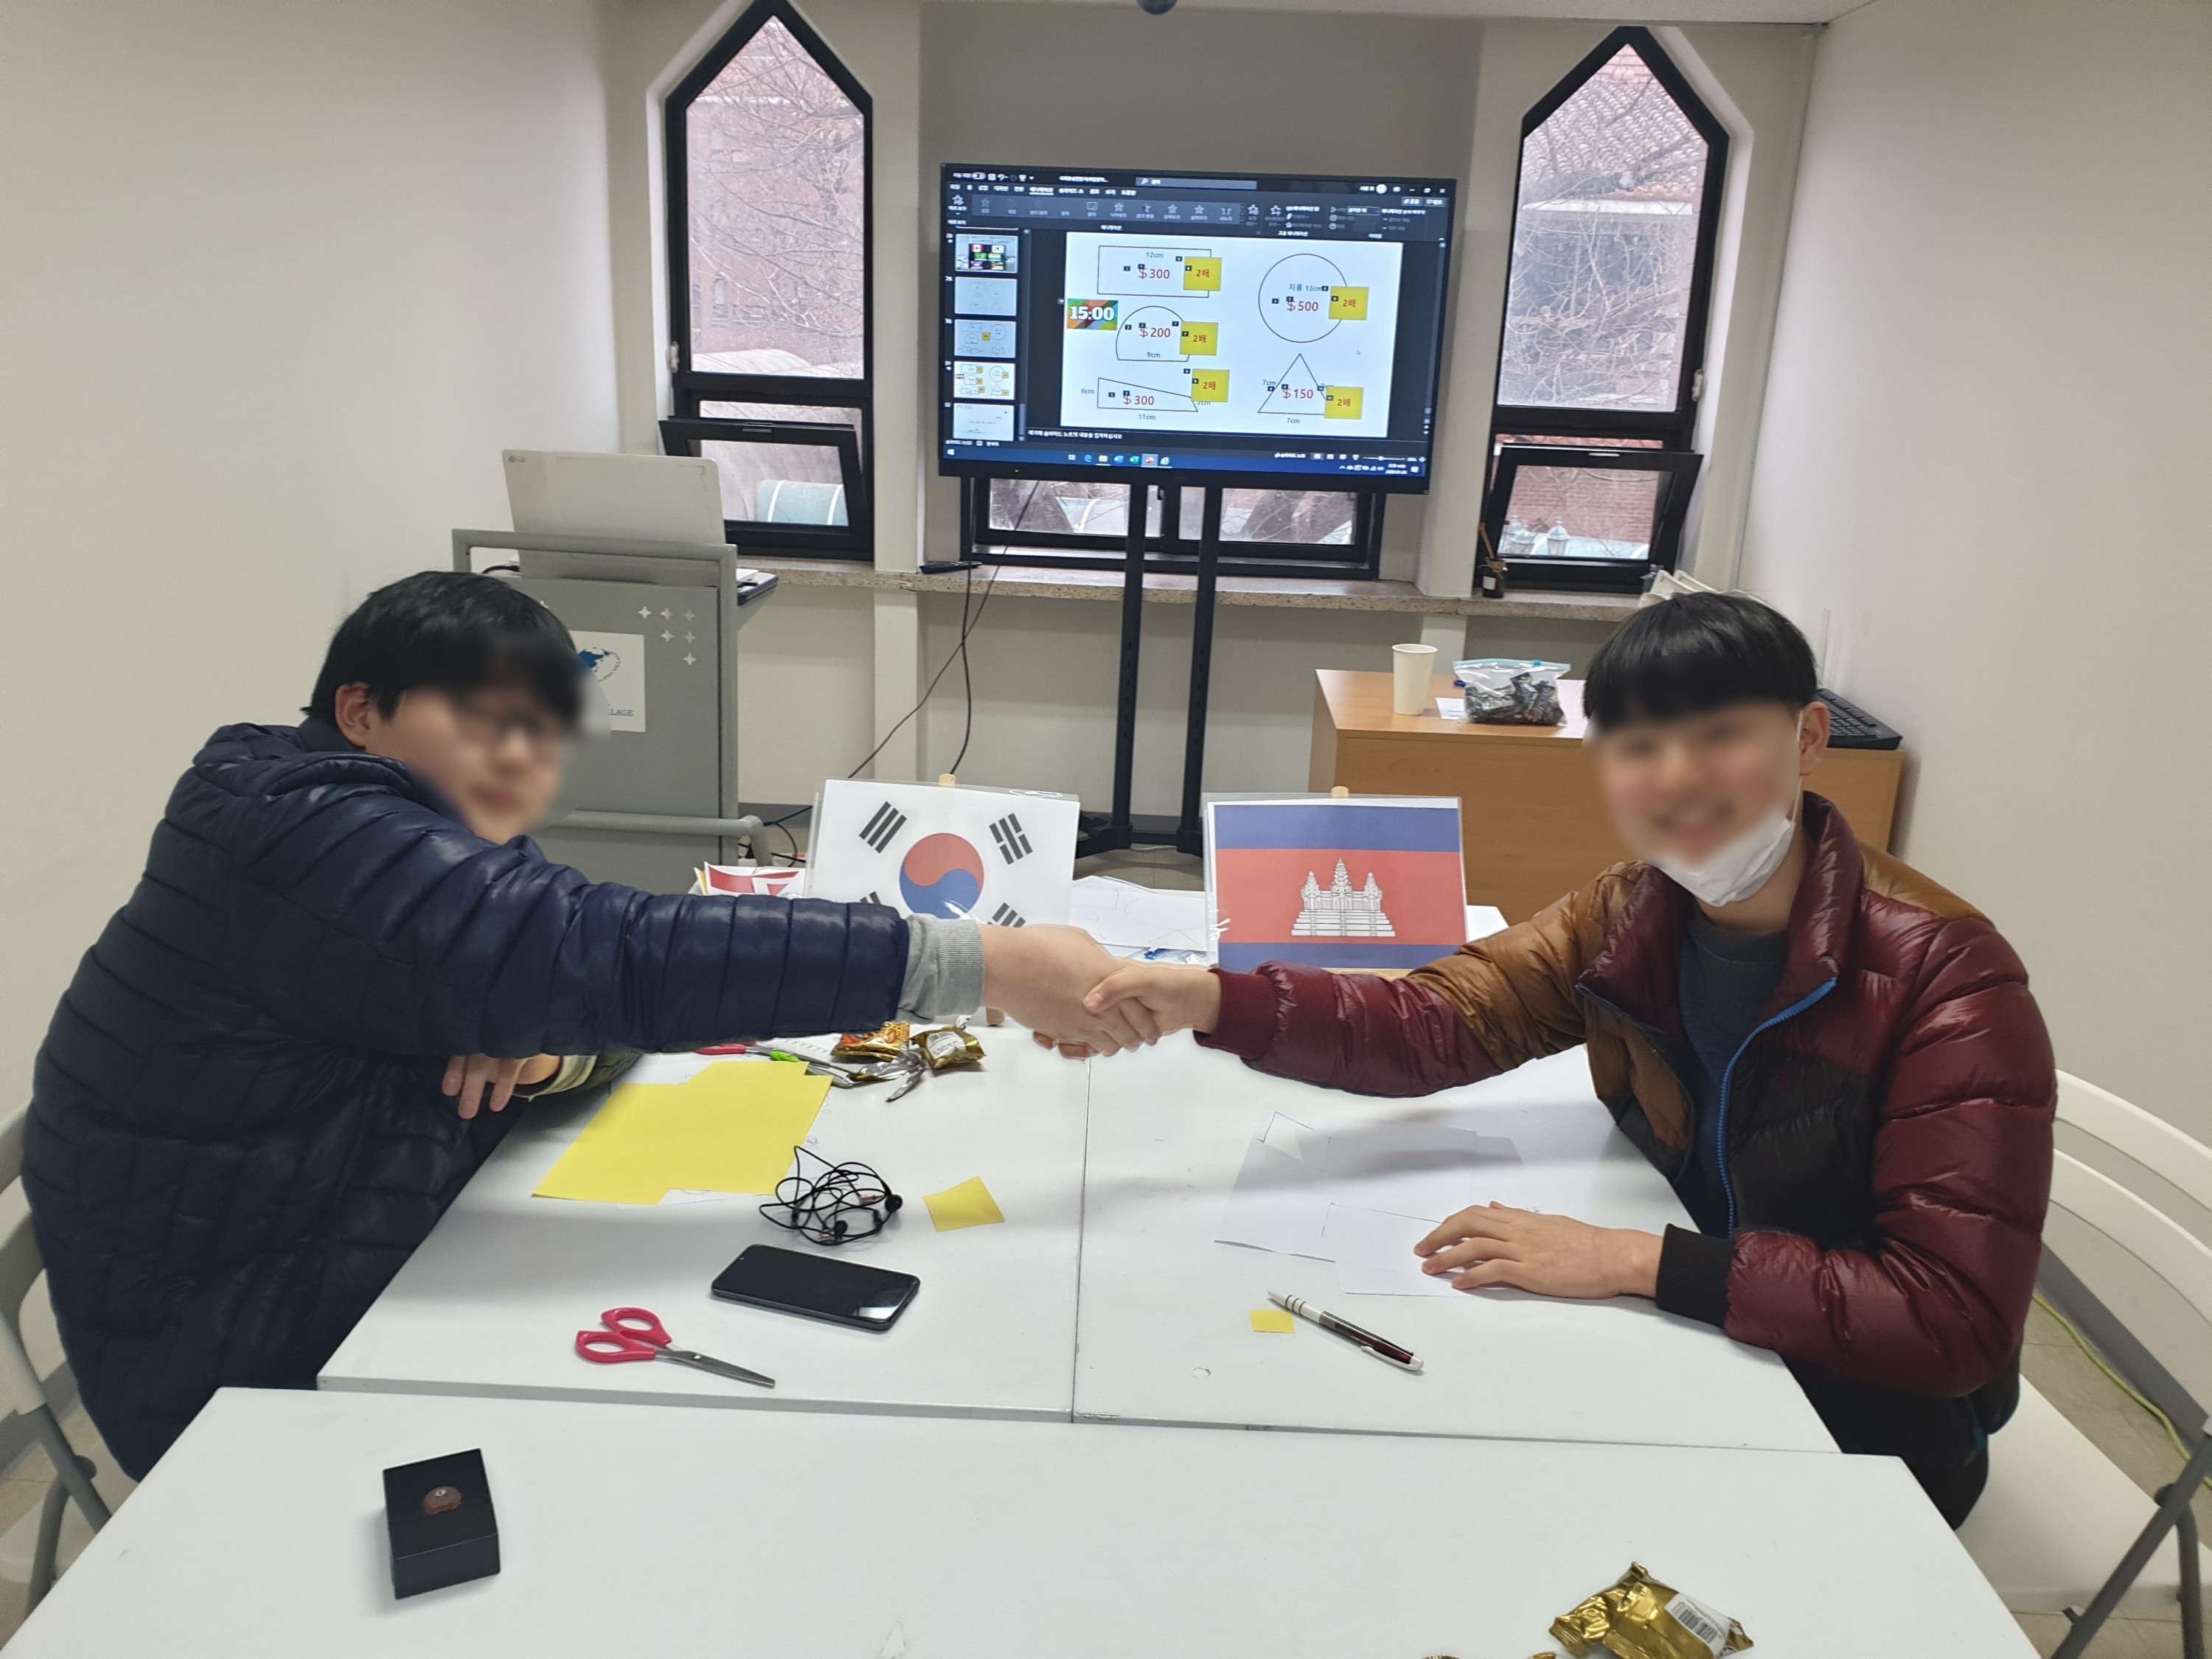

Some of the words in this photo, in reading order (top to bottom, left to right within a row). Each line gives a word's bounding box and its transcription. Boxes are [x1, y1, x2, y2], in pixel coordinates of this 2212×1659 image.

[1196, 268, 1210, 278] 2배
[1343, 299, 1357, 307] 2배
[1070, 305, 1115, 321] 15:00
[1193, 334, 1206, 343] 2배
[1203, 381, 1216, 390] 2배
[1337, 398, 1351, 407] 2배
